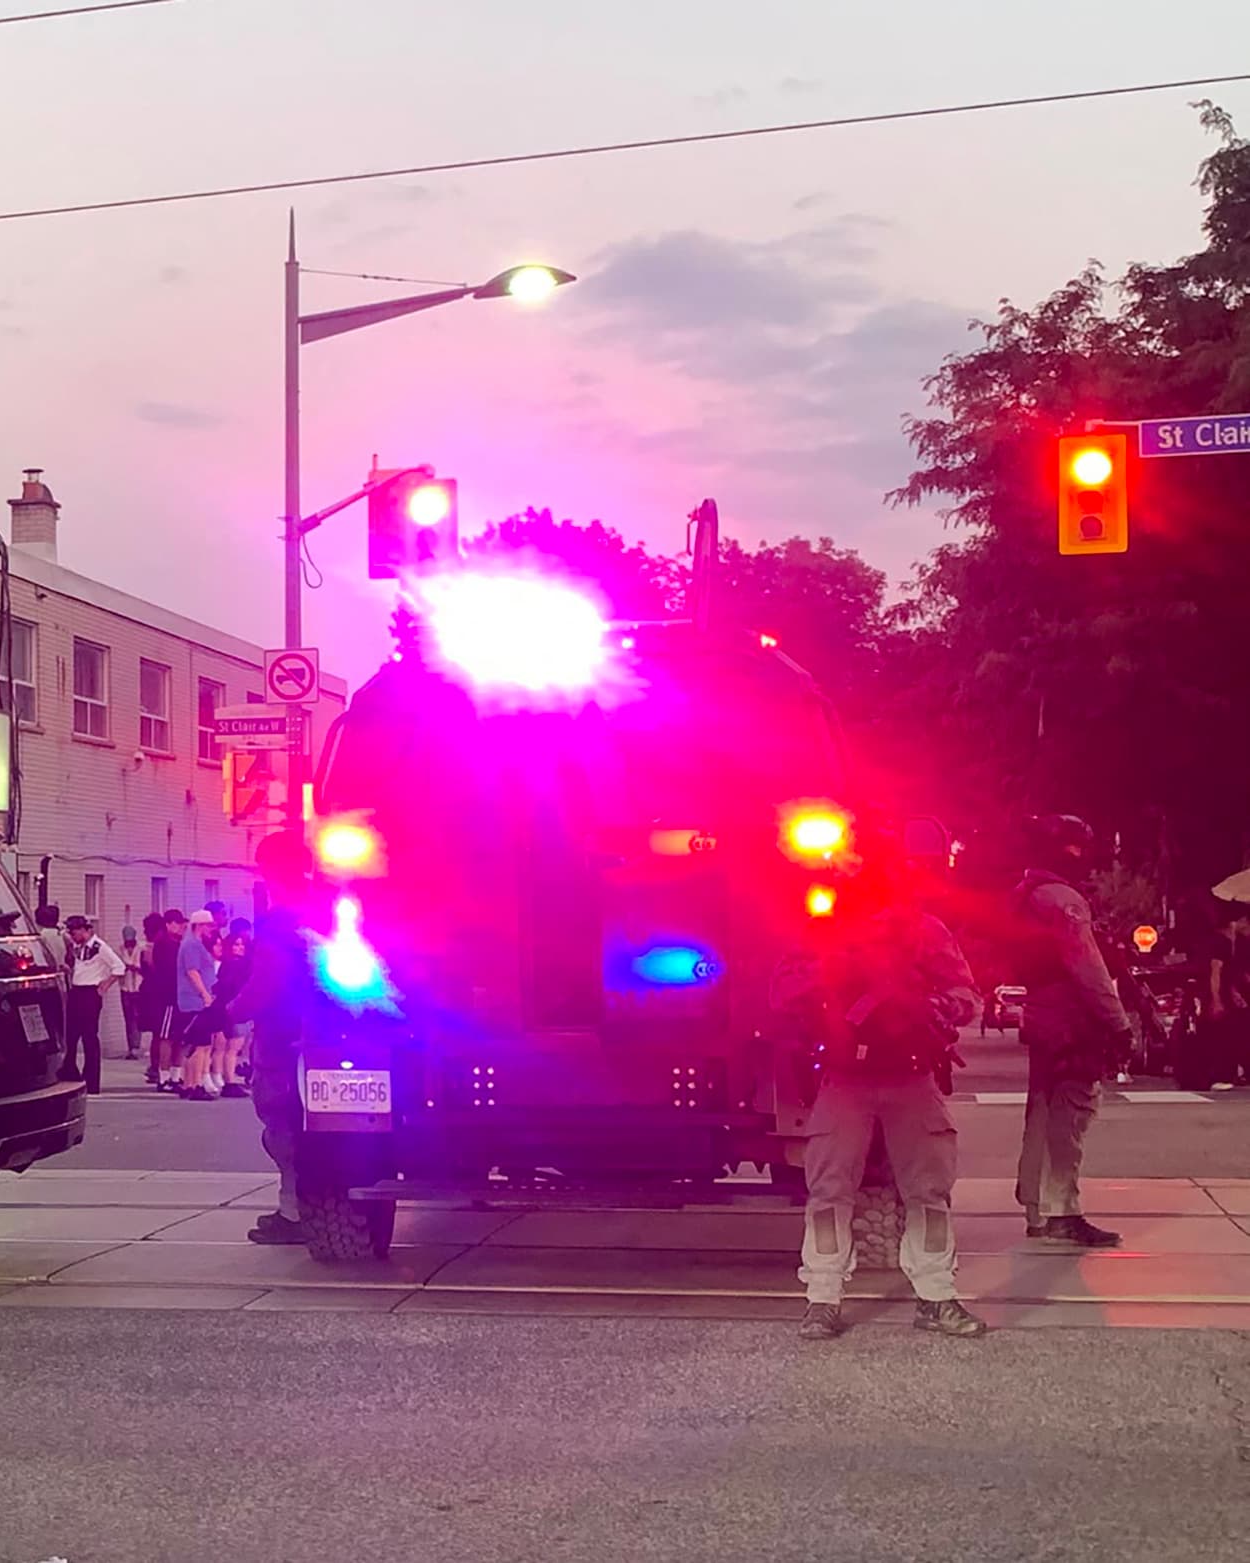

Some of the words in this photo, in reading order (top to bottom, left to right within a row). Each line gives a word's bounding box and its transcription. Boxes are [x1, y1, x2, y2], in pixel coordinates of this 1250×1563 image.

[1158, 425, 1183, 449] St
[218, 721, 228, 732] St
[231, 720, 257, 732] Clair
[340, 1081, 387, 1102] 25056
